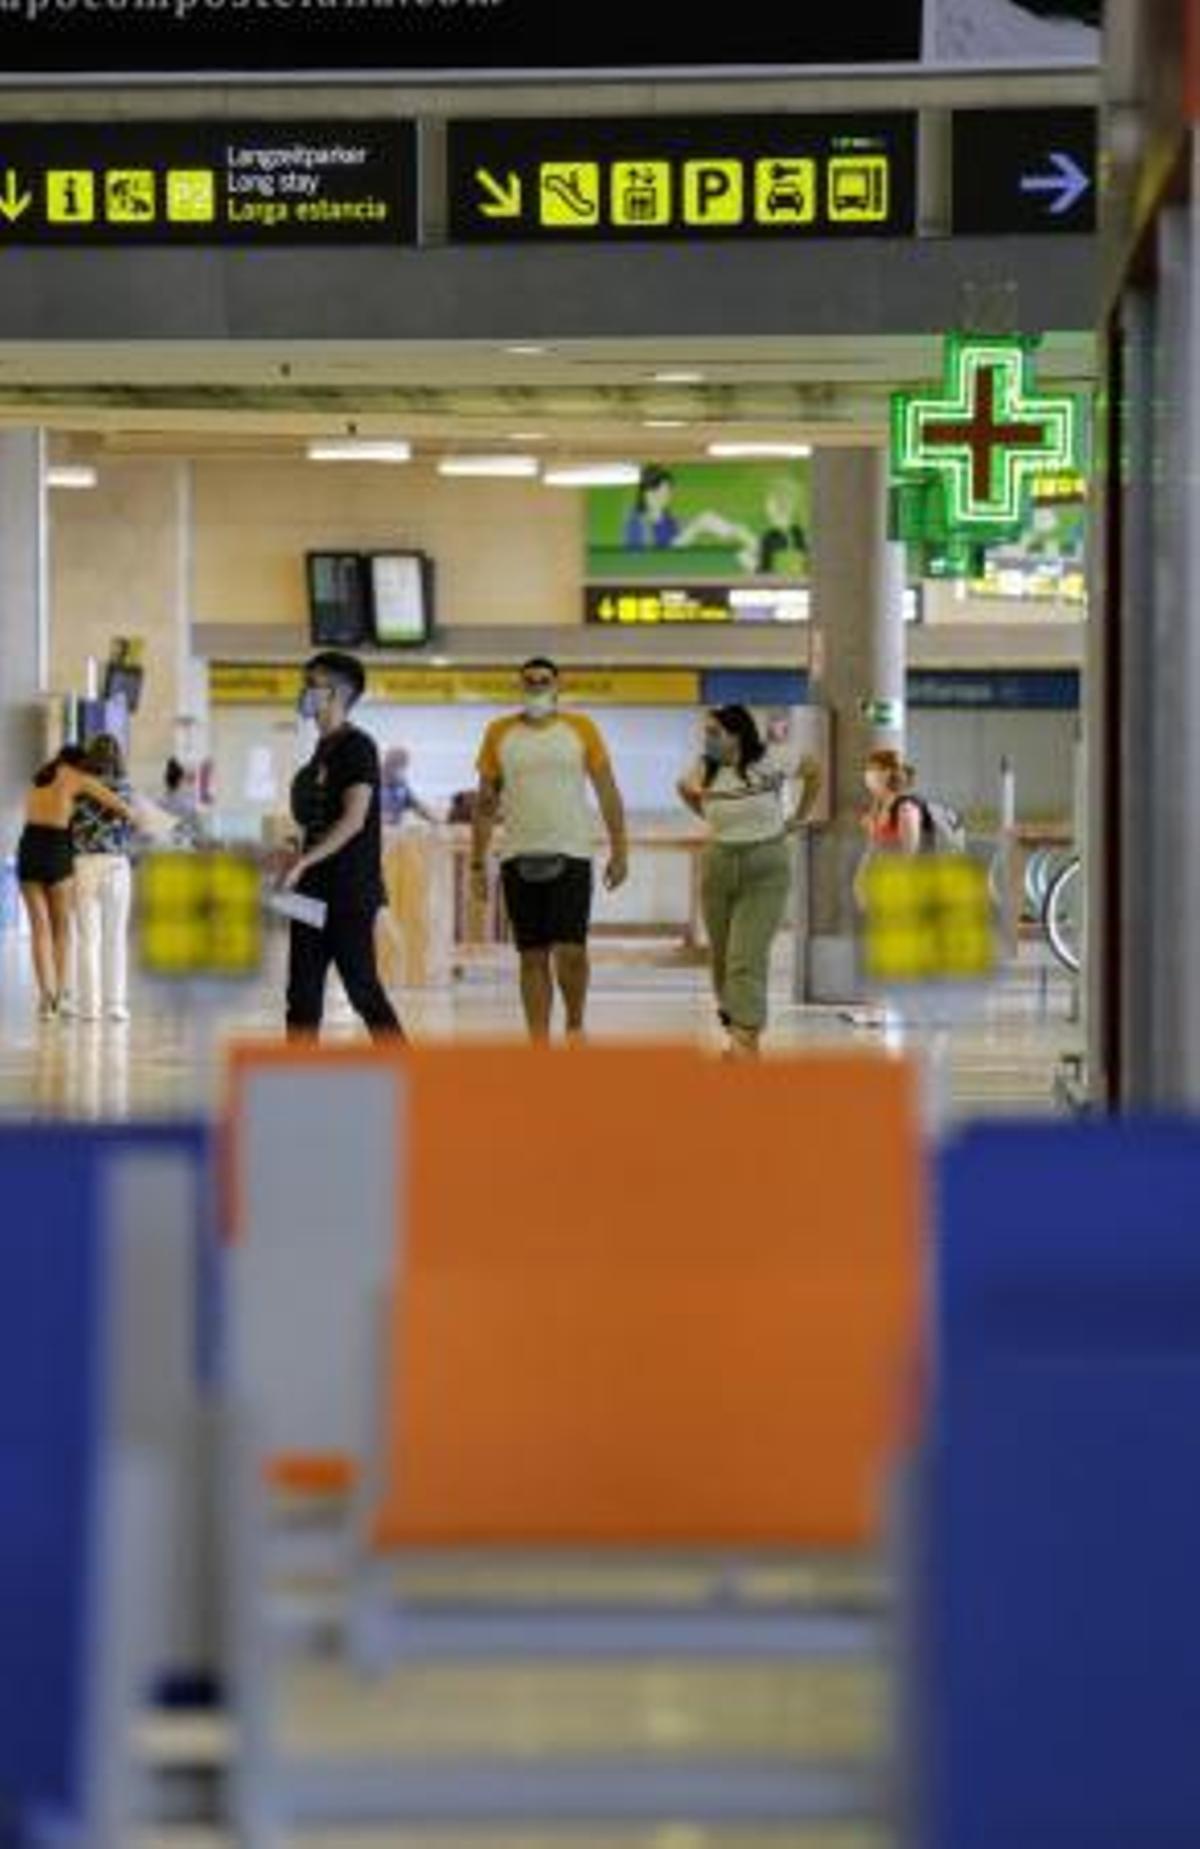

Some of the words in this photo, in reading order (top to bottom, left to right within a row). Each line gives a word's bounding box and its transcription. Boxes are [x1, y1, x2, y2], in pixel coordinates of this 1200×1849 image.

[228, 171, 275, 195] Long
[280, 171, 320, 195] stay
[697, 163, 731, 215] P
[228, 199, 288, 224] Larga
[297, 198, 388, 222] estancia
